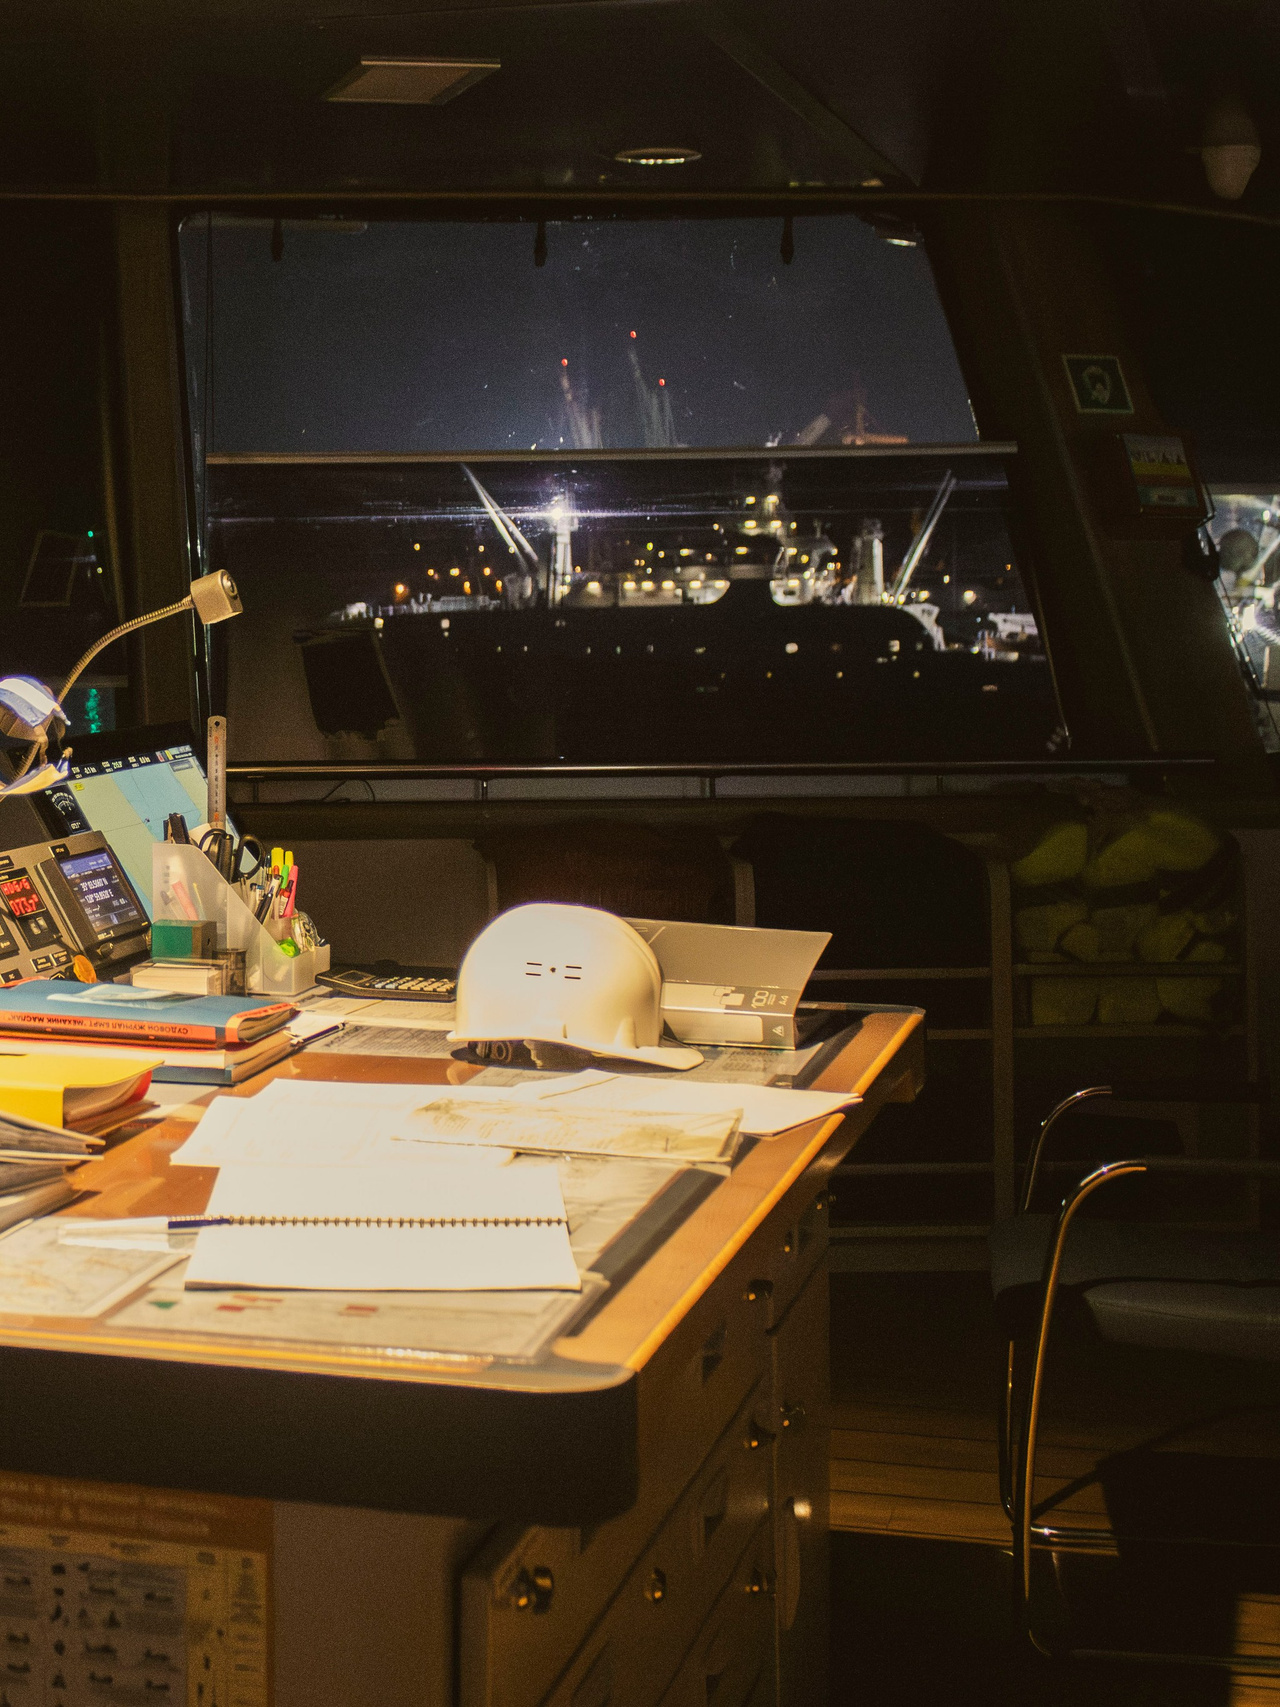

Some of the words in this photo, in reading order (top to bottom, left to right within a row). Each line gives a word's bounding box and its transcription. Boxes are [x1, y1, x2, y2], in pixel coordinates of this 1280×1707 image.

[750, 990, 770, 1009] 100
[778, 995, 789, 1006] A4
[117, 1021, 147, 1031] ЖУРНАЛ
